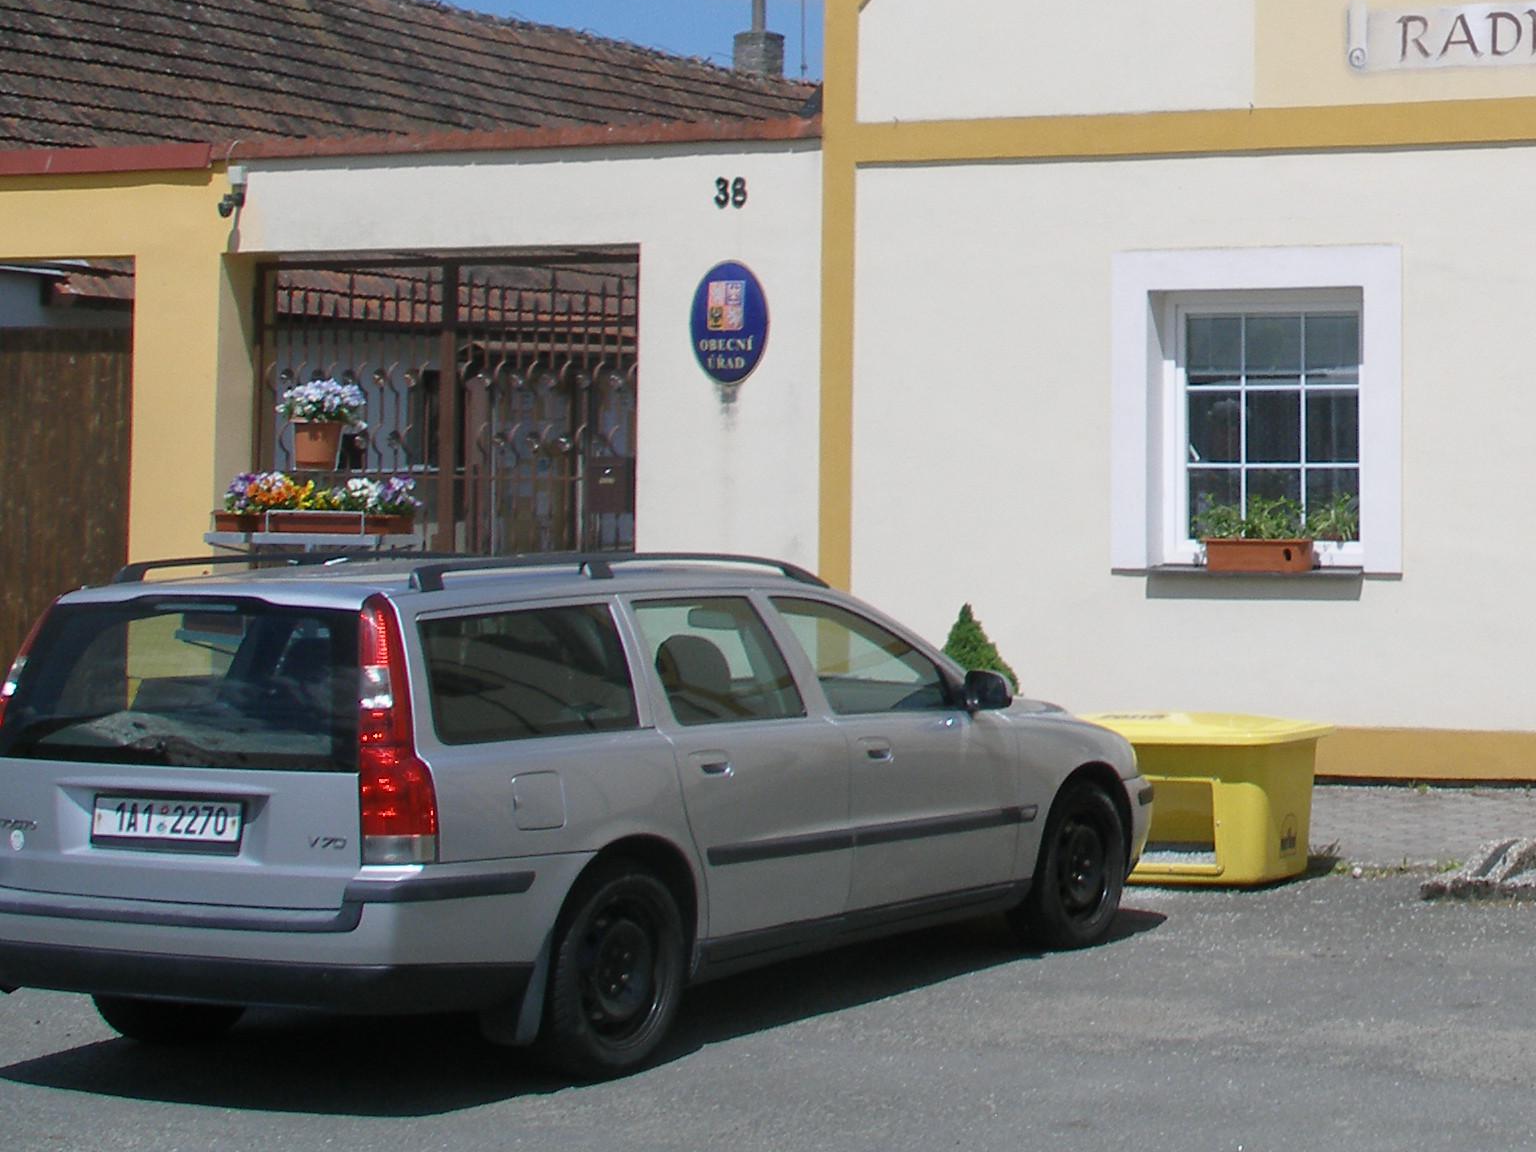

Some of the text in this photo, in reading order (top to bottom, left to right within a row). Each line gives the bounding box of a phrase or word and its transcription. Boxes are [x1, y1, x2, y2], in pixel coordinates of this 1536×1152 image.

[714, 177, 747, 209] 38
[699, 334, 754, 351] OBECNÍ
[707, 353, 745, 369] ÚŘAD
[115, 801, 228, 836] 1A1 2270
[308, 836, 348, 849] V70
